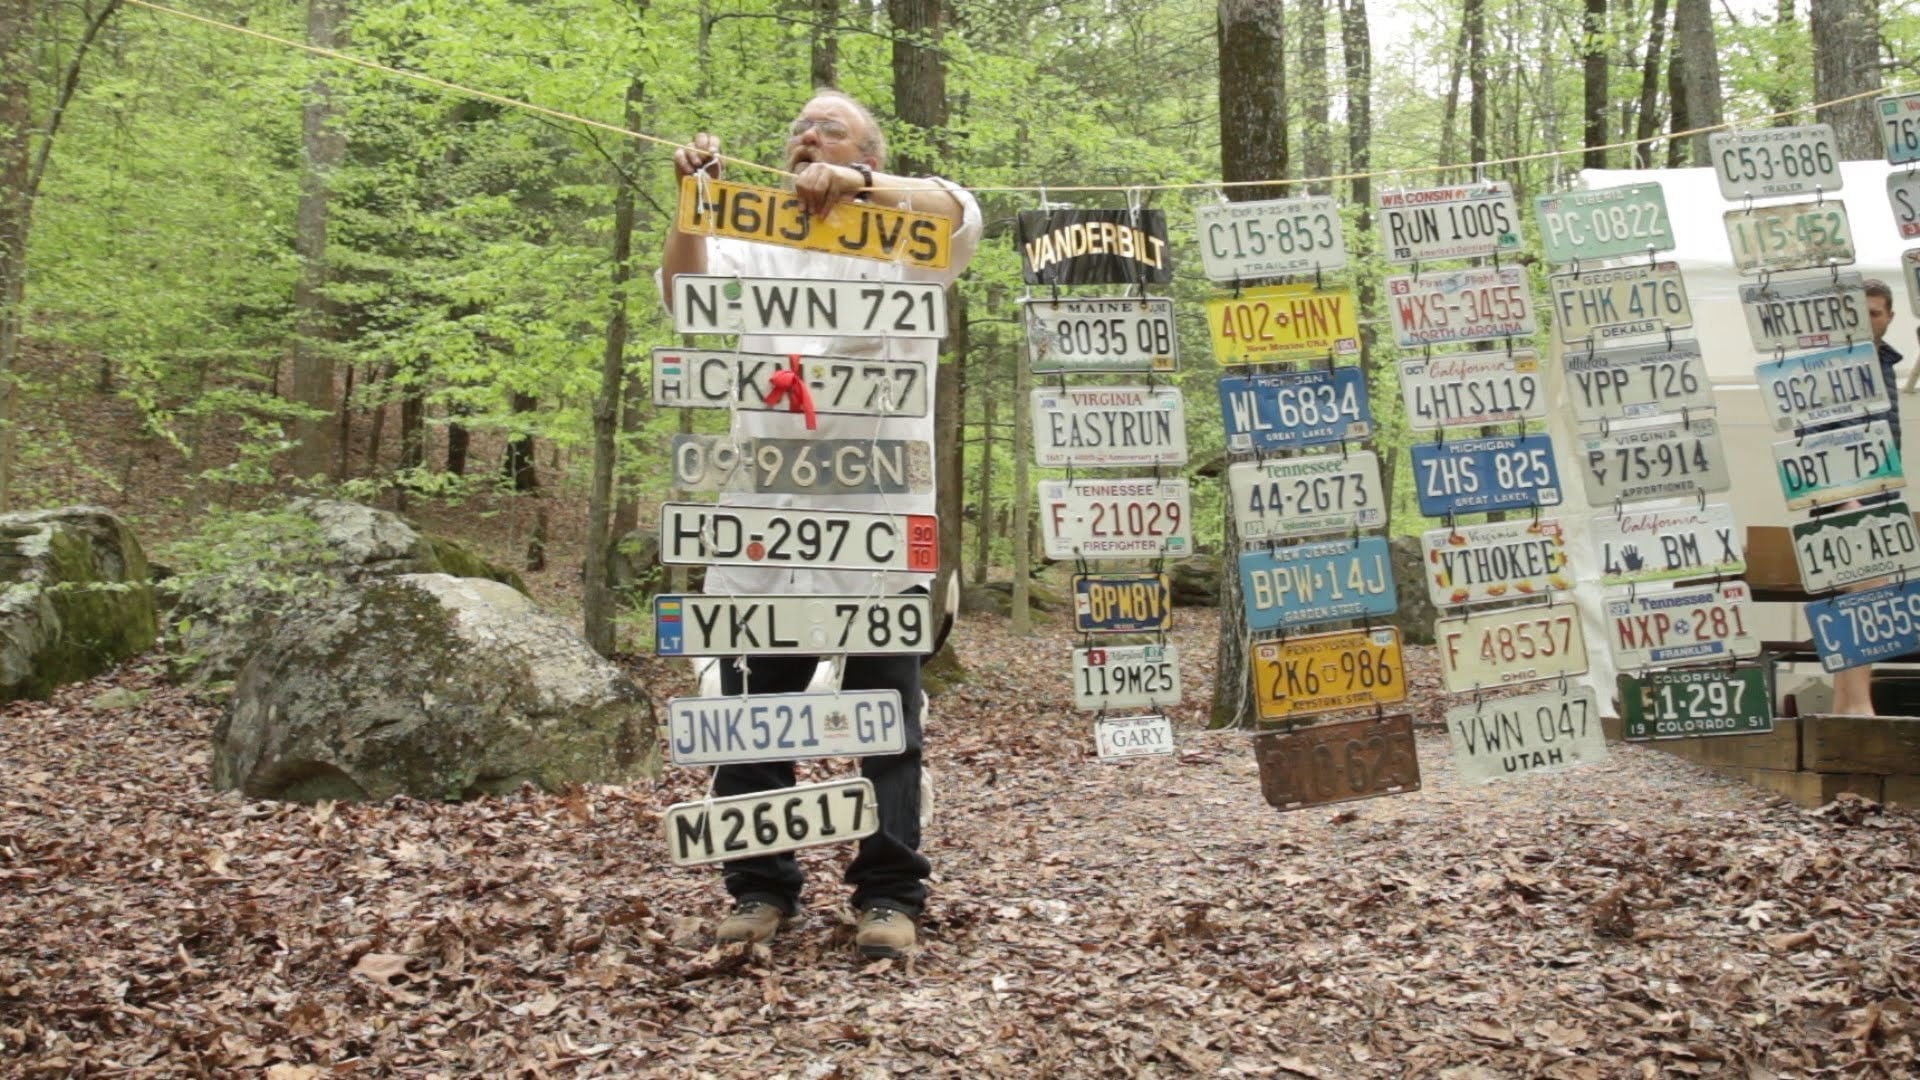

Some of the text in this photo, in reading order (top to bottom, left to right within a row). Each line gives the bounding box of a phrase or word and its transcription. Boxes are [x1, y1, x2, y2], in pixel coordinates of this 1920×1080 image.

[1886, 117, 1920, 153] 76
[1723, 142, 1833, 182] C53-686
[1382, 190, 1452, 205] WISCONSIN
[1762, 183, 1803, 192] TRAILER
[693, 187, 938, 261] H613 JVS
[1389, 208, 1440, 246] RUN
[1026, 221, 1165, 272] VANDERBILT
[1208, 214, 1333, 258] C15-853
[1244, 259, 1309, 272] TRAILER
[1583, 270, 1648, 286] GEORGIA
[861, 288, 936, 331] 721
[1067, 303, 1133, 313] MAINE
[1396, 285, 1526, 331] WXS-3455
[1560, 280, 1682, 327] FHK 476
[1222, 297, 1342, 343] 402 HNY
[1756, 295, 1858, 338] WRITERS
[1058, 319, 1127, 355] 8035
[1410, 322, 1522, 342] NORTH CAROLINA
[1602, 323, 1654, 337] DEKALB
[1429, 360, 1505, 379] California
[662, 380, 681, 399] H
[1576, 360, 1697, 407] YPP 726
[1774, 364, 1875, 413] 962 HIN
[1071, 393, 1143, 407] VIRGINIA
[1230, 382, 1359, 432] WL 6834
[1416, 376, 1535, 419] 4HTS119
[1048, 410, 1171, 447] EASYRUN
[1266, 428, 1333, 441] GREAT LAKES
[1615, 430, 1677, 445] VIRGINIA
[1450, 440, 1516, 453] MICHIGAN
[1265, 460, 1343, 478] Tennessee
[1616, 439, 1709, 482] 75-914
[1783, 451, 1830, 491] DBT
[1845, 439, 1892, 478] 751
[1422, 449, 1550, 497] ZHS 825
[1074, 485, 1154, 496] TENNESSEE
[1622, 480, 1694, 498] APPORTIONED
[1455, 495, 1488, 506] GREAT
[1620, 514, 1707, 535] California
[866, 521, 895, 563] C
[1083, 540, 1156, 551] FIREFIGHTER
[1468, 529, 1518, 543] Virginia
[1660, 532, 1702, 570] BM
[1715, 528, 1737, 563] X
[1440, 539, 1560, 586] VTHOKEE
[1836, 560, 1894, 580] COLORADO
[1284, 602, 1363, 621] GARDEN STATE
[1638, 593, 1714, 611] Tennessee
[691, 603, 922, 648] YKL 789
[1617, 604, 1747, 650] NXP 281
[1817, 613, 1840, 652] C
[660, 635, 681, 650] LT
[1446, 617, 1572, 671] F 48537
[1659, 644, 1713, 659] FRANKLIN
[1860, 640, 1902, 656] TRAILER
[1093, 653, 1101, 664] 3
[1082, 664, 1172, 696] 119M25
[1268, 648, 1392, 700] 2K6 986
[1501, 670, 1537, 682] OHIO
[1653, 671, 1730, 684] COLORFUL
[1293, 696, 1343, 709] KEYSTONE
[676, 701, 897, 755] JNK521 GP
[1458, 699, 1587, 755] VWN 047
[1631, 723, 1645, 734] 19
[1656, 717, 1736, 732] COLORADO
[1748, 716, 1763, 727] 51
[1112, 727, 1165, 747] GARY
[1503, 748, 1564, 772] UTAH
[675, 788, 865, 859] M26617
